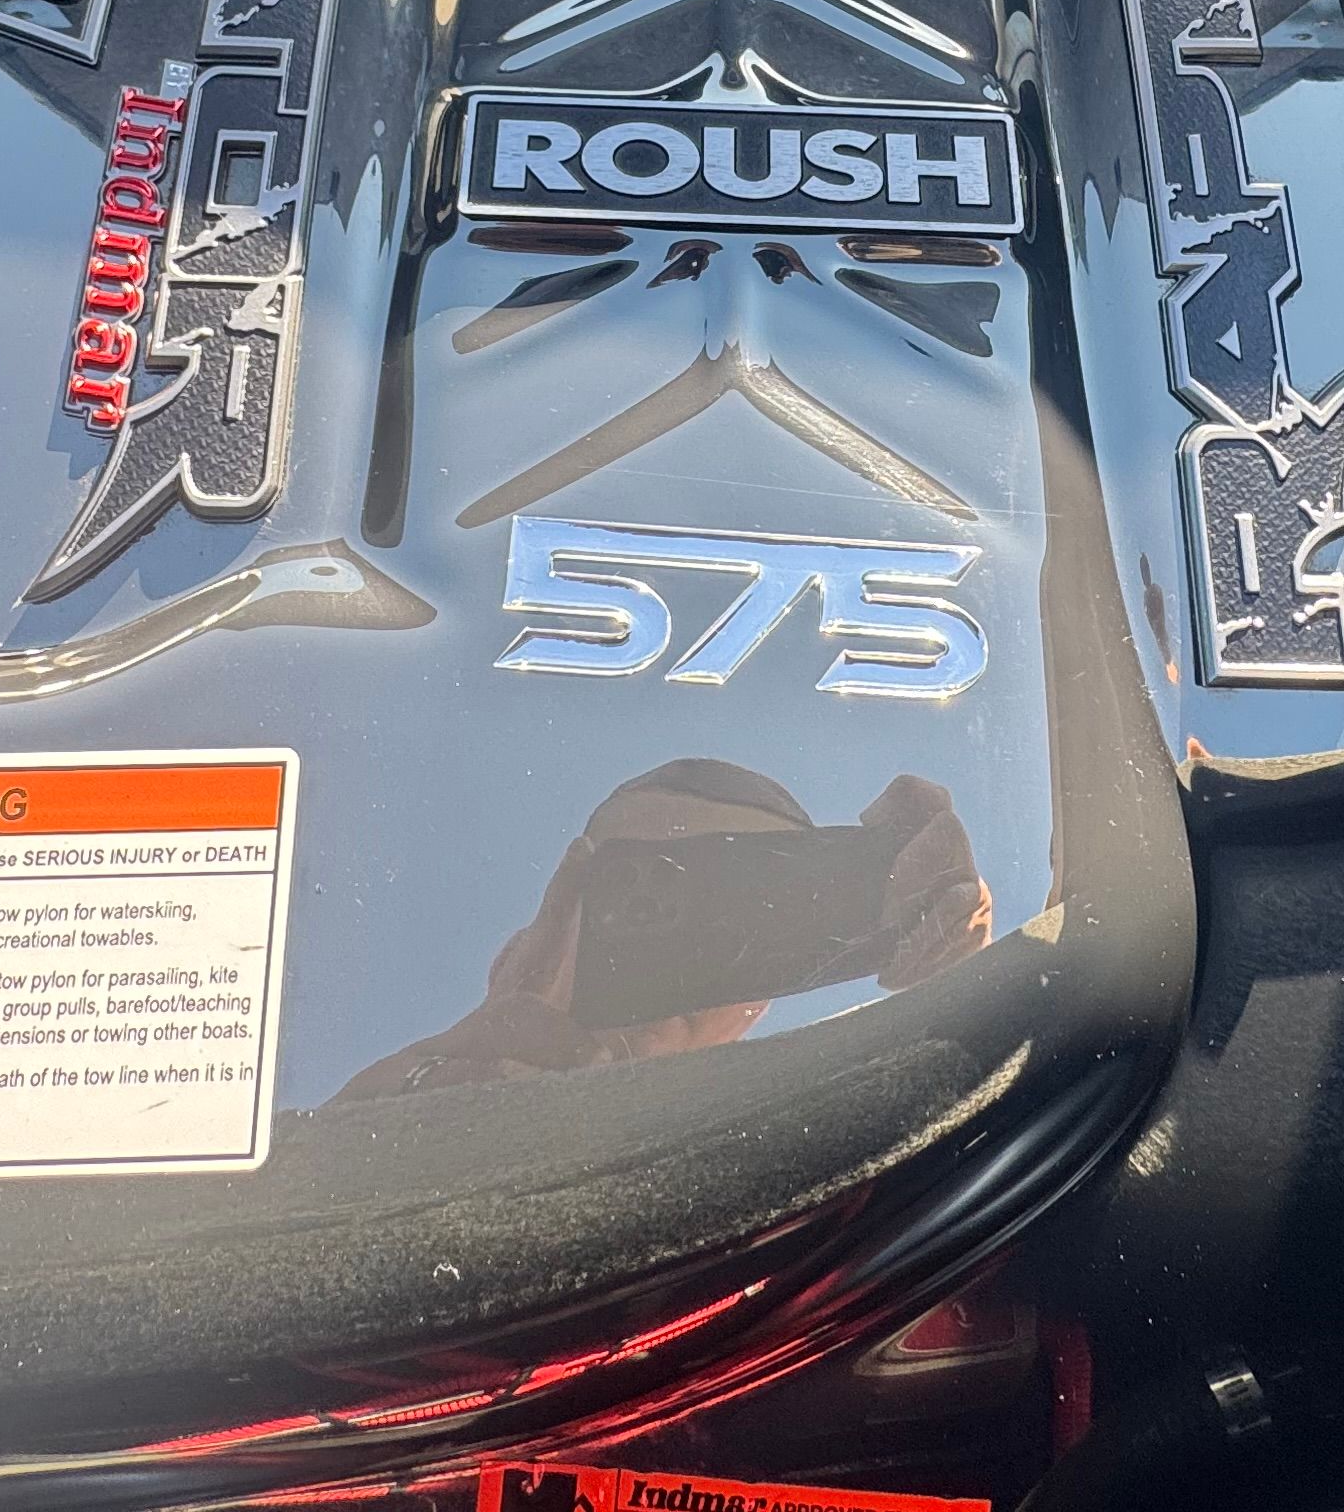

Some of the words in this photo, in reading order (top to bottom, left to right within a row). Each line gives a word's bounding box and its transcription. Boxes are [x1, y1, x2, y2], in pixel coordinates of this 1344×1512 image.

[492, 119, 991, 207] ROUSH
[70, 88, 185, 428] Indmar
[493, 515, 988, 701] 575
[23, 849, 104, 866] SERIOUS
[110, 848, 177, 864] INJURY
[182, 851, 200, 862] or
[206, 846, 266, 862] DEATH
[23, 904, 69, 926] pylon
[73, 902, 97, 921] for
[100, 900, 197, 922] waterskiing,
[80, 928, 158, 947] towables.
[30, 970, 76, 994] pylon
[81, 969, 105, 988] for
[107, 967, 203, 992] parasailing,
[209, 965, 238, 984] kite
[2, 1002, 52, 1022] group
[56, 996, 100, 1020] pulls,
[106, 992, 251, 1016] barefoot/teaching
[70, 1028, 90, 1043] or
[93, 1023, 149, 1046] towing
[153, 1022, 198, 1041] other
[201, 1021, 253, 1040] boats.
[29, 1067, 49, 1087] of
[51, 1067, 79, 1087] the
[84, 1067, 115, 1086] tow
[118, 1065, 149, 1084] line
[154, 1064, 200, 1083] when
[204, 1063, 215, 1082] it
[220, 1063, 234, 1082] is
[239, 1063, 253, 1081] in
[628, 1479, 768, 1512] Indmar
